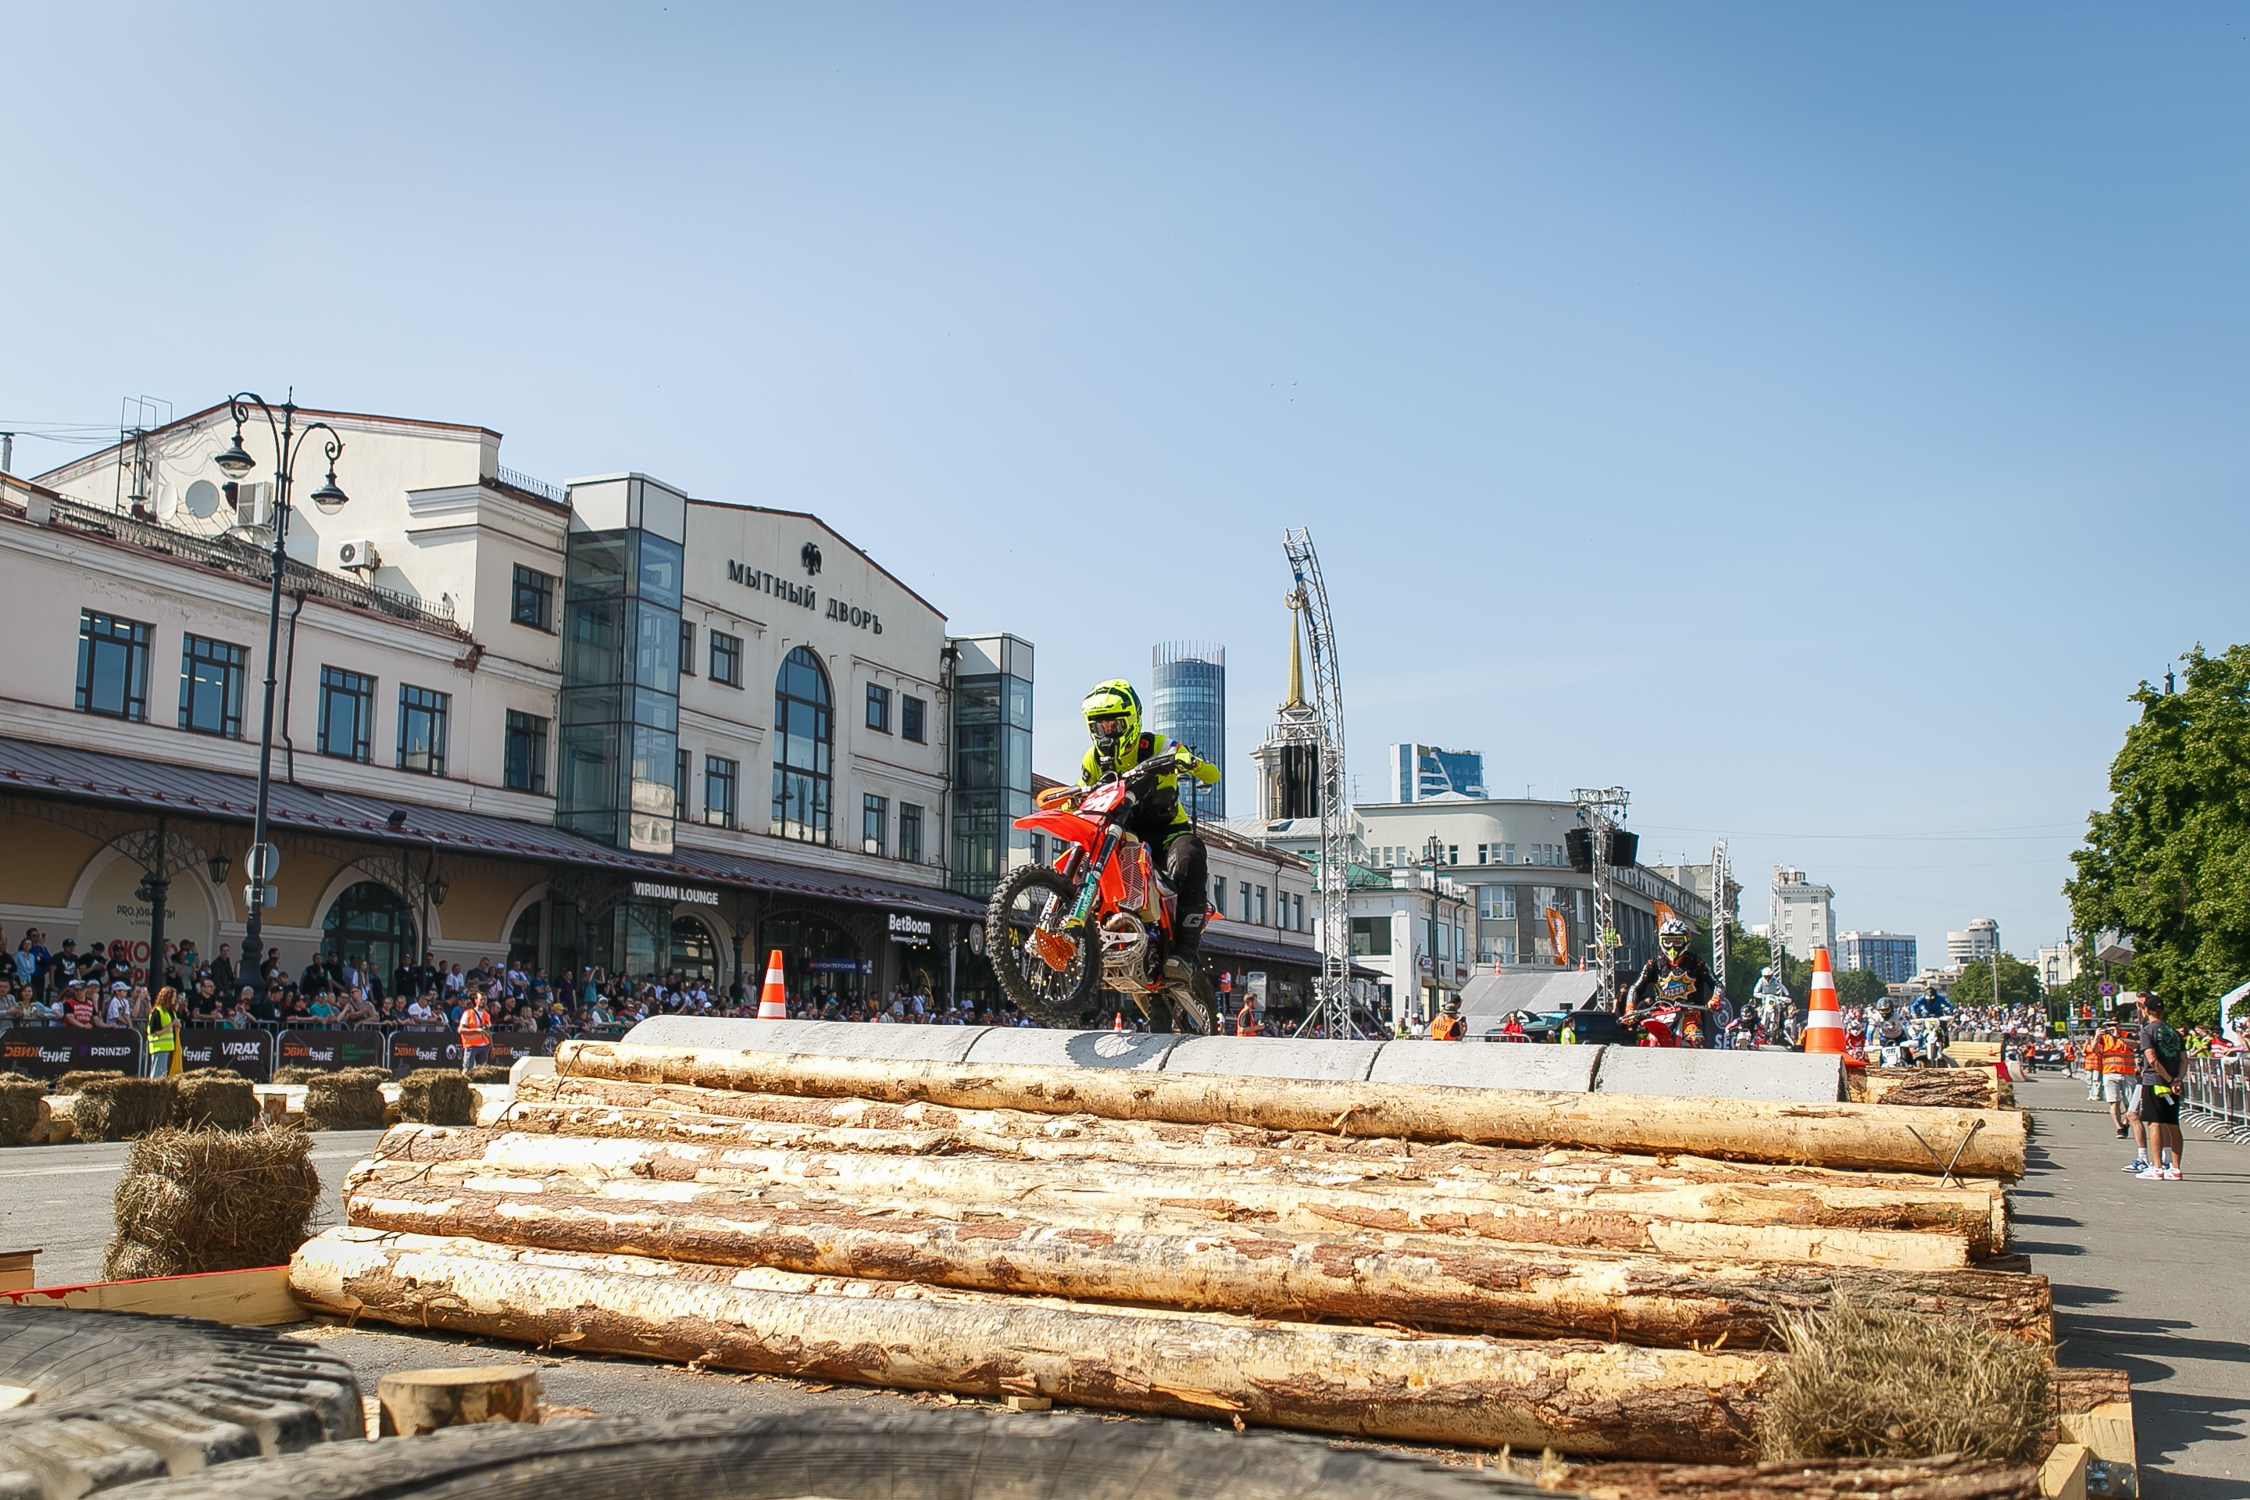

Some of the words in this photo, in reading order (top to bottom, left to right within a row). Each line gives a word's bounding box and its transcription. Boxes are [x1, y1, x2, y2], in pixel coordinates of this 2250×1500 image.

[728, 559, 816, 611] МЫТНЫЙ
[826, 597, 883, 635] ДВОРЪ
[632, 882, 678, 900] VIRIDIAN
[680, 888, 719, 905] LOUNGE
[889, 914, 931, 934] BetBoom
[91, 1046, 131, 1056] PRINZIP
[221, 1042, 261, 1056] VIRAX
